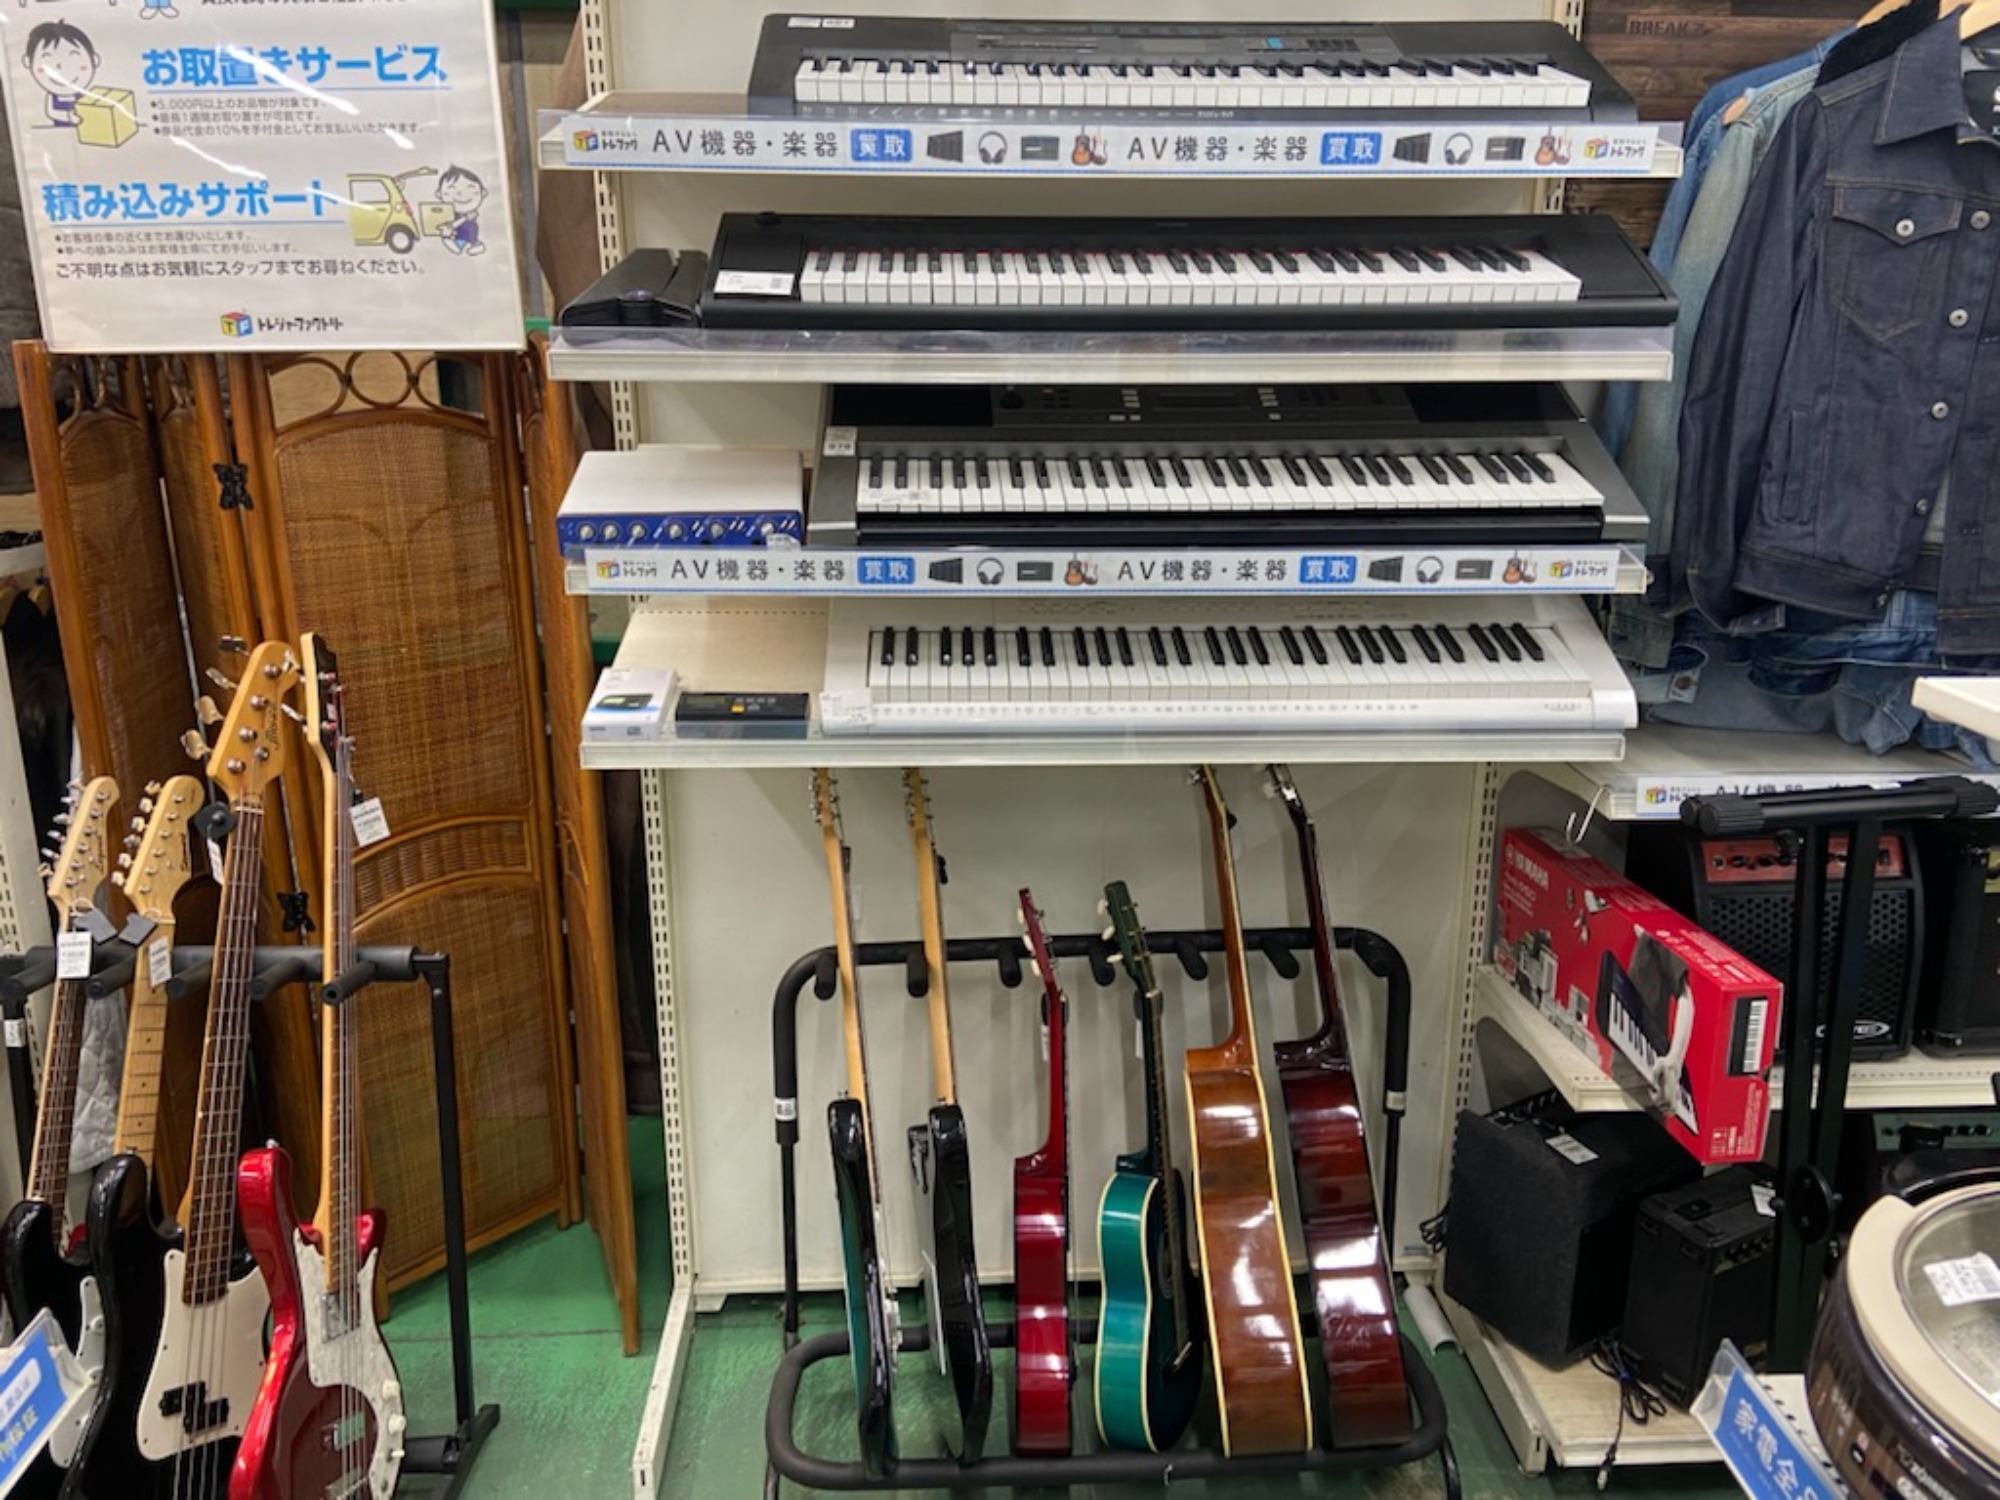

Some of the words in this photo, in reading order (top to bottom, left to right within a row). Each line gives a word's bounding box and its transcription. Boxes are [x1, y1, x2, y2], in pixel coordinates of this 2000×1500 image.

[142, 45, 448, 87] お取置きサービス
[652, 129, 839, 158] AV機器・楽器
[857, 132, 907, 159] 買取
[1127, 136, 1308, 162] AV機器・楽器
[1326, 136, 1375, 162] 買取
[42, 180, 340, 222] 積み込みサポート
[56, 259, 425, 278] ご不明な点はお気軽にスタッフまでお尋ねください。
[670, 559, 846, 582] AV機器・楽器
[864, 560, 910, 582] 買取
[1117, 559, 1288, 582] AV機器・楽器
[1306, 560, 1352, 581] 買取
